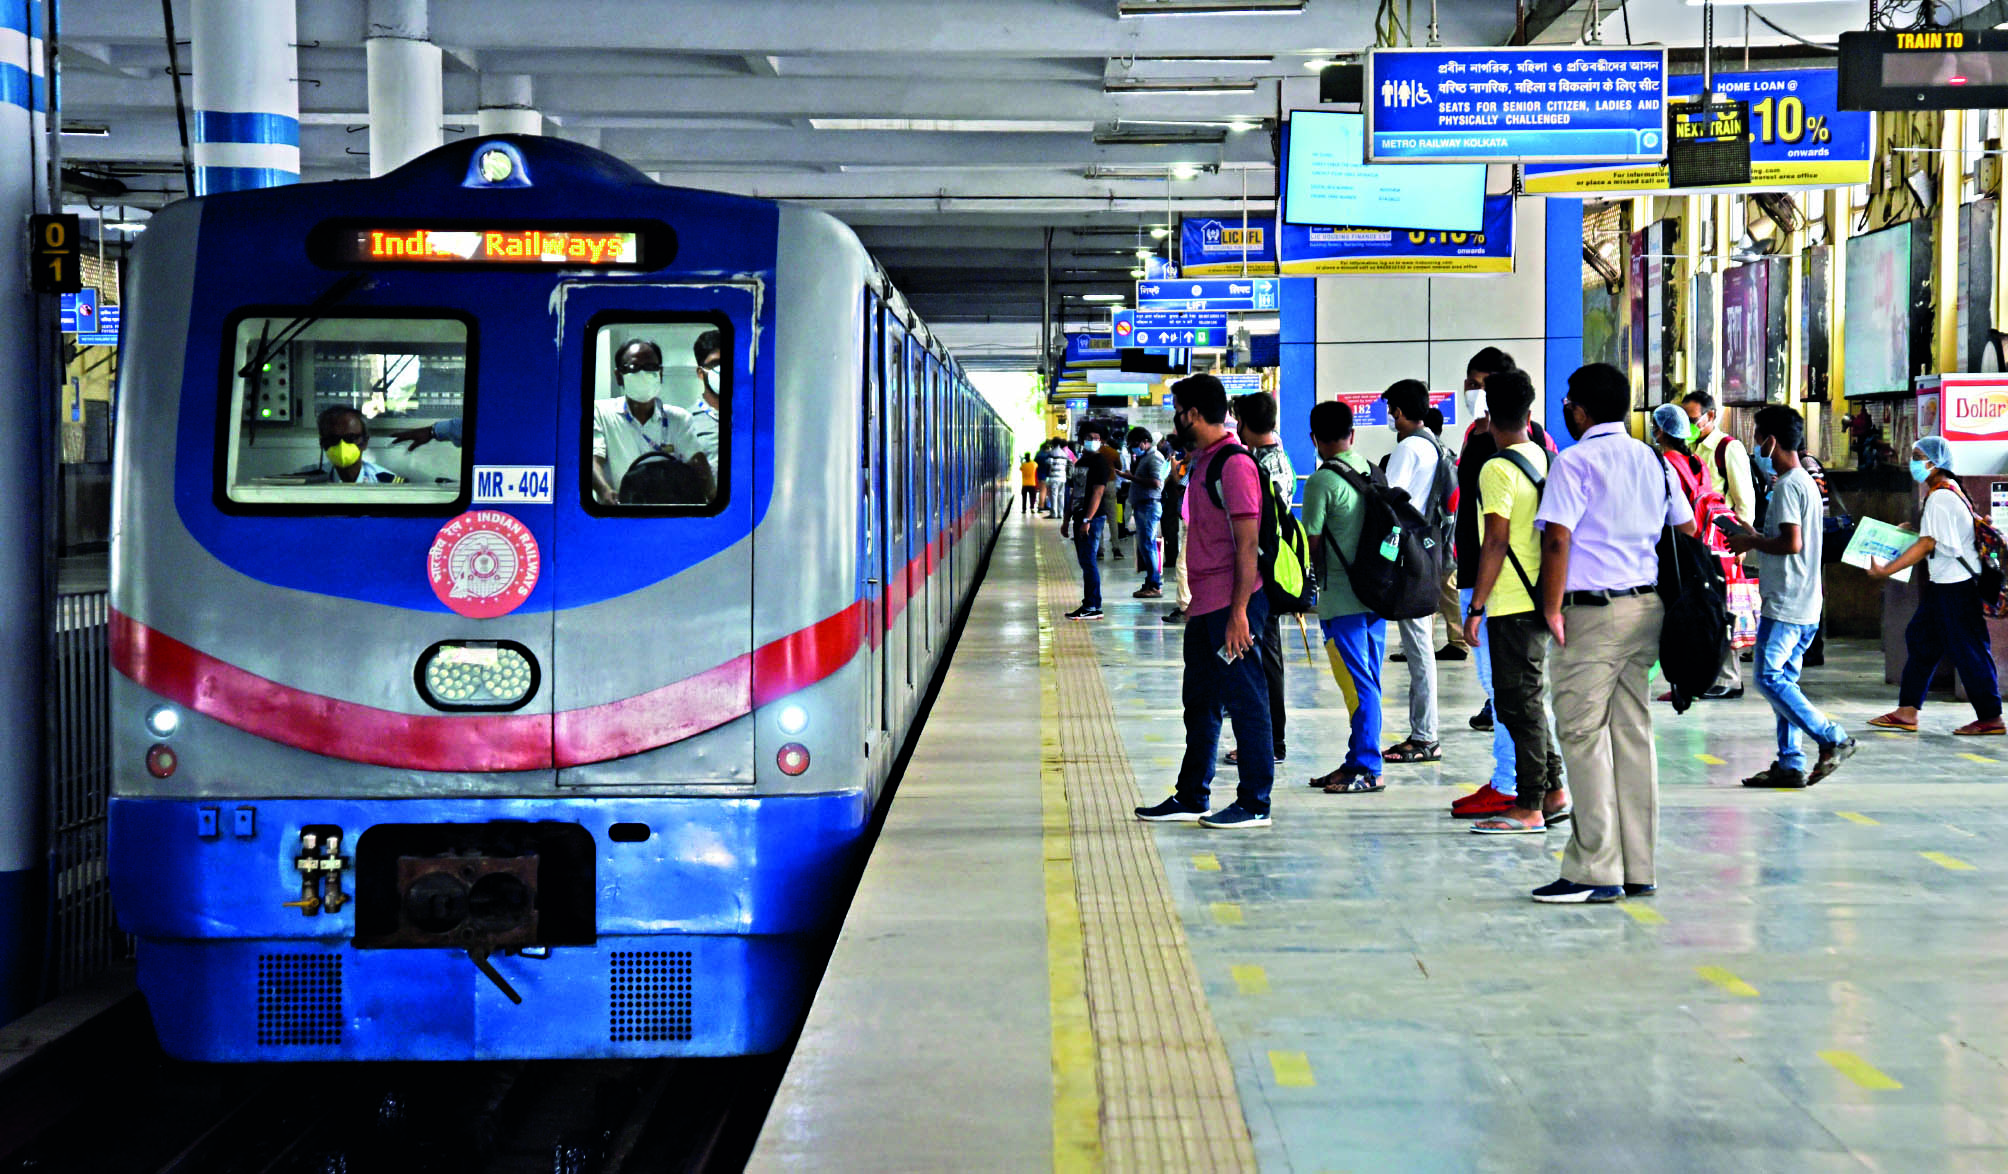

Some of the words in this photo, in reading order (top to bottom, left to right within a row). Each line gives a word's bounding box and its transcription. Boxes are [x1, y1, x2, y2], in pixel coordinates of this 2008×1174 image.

[1897, 33, 1942, 49] TRAIN
[1945, 32, 1963, 48] TO
[1516, 59, 1547, 73] মহিলা
[1552, 63, 1562, 72] ও
[1629, 61, 1659, 72] আসন
[1438, 80, 1467, 94] वरिष्ठ
[1469, 79, 1512, 94] नागरिक,
[1514, 79, 1546, 93] महिला
[1548, 82, 1557, 92] व
[1558, 77, 1600, 92] विकलांग
[1602, 78, 1613, 92] के
[1615, 78, 1636, 93] लिए
[1638, 77, 1660, 91] सीट
[1717, 82, 1750, 92] HOME
[1754, 81, 1785, 91] LOAN
[1787, 81, 1798, 91] @
[1439, 102, 1470, 112] SEATS
[1476, 101, 1497, 112] FOR
[1503, 101, 1541, 112] SENIOR
[1547, 100, 1590, 112] CITIZEN,
[1595, 100, 1632, 110] LADIES
[1638, 99, 1659, 110] AND
[1439, 114, 1498, 125] PHYSICALLY
[1505, 114, 1570, 124] CHALLENGED
[1381, 139, 1417, 148] METRO
[1419, 138, 1461, 148] RAILWAY
[1463, 138, 1508, 147] KOLKATA
[1787, 147, 1829, 157] onwards
[45, 222, 65, 247] 0
[1223, 231, 1239, 243] LIC
[486, 231, 624, 263] Railways
[48, 257, 62, 282] 1
[1186, 300, 1207, 310] LIFT
[1353, 404, 1371, 414] 182
[1956, 397, 2007, 418] Dollar
[478, 471, 503, 497] MR
[518, 471, 549, 498] 404
[477, 512, 522, 535] INDIAN
[518, 533, 539, 596] RAILWAYS
